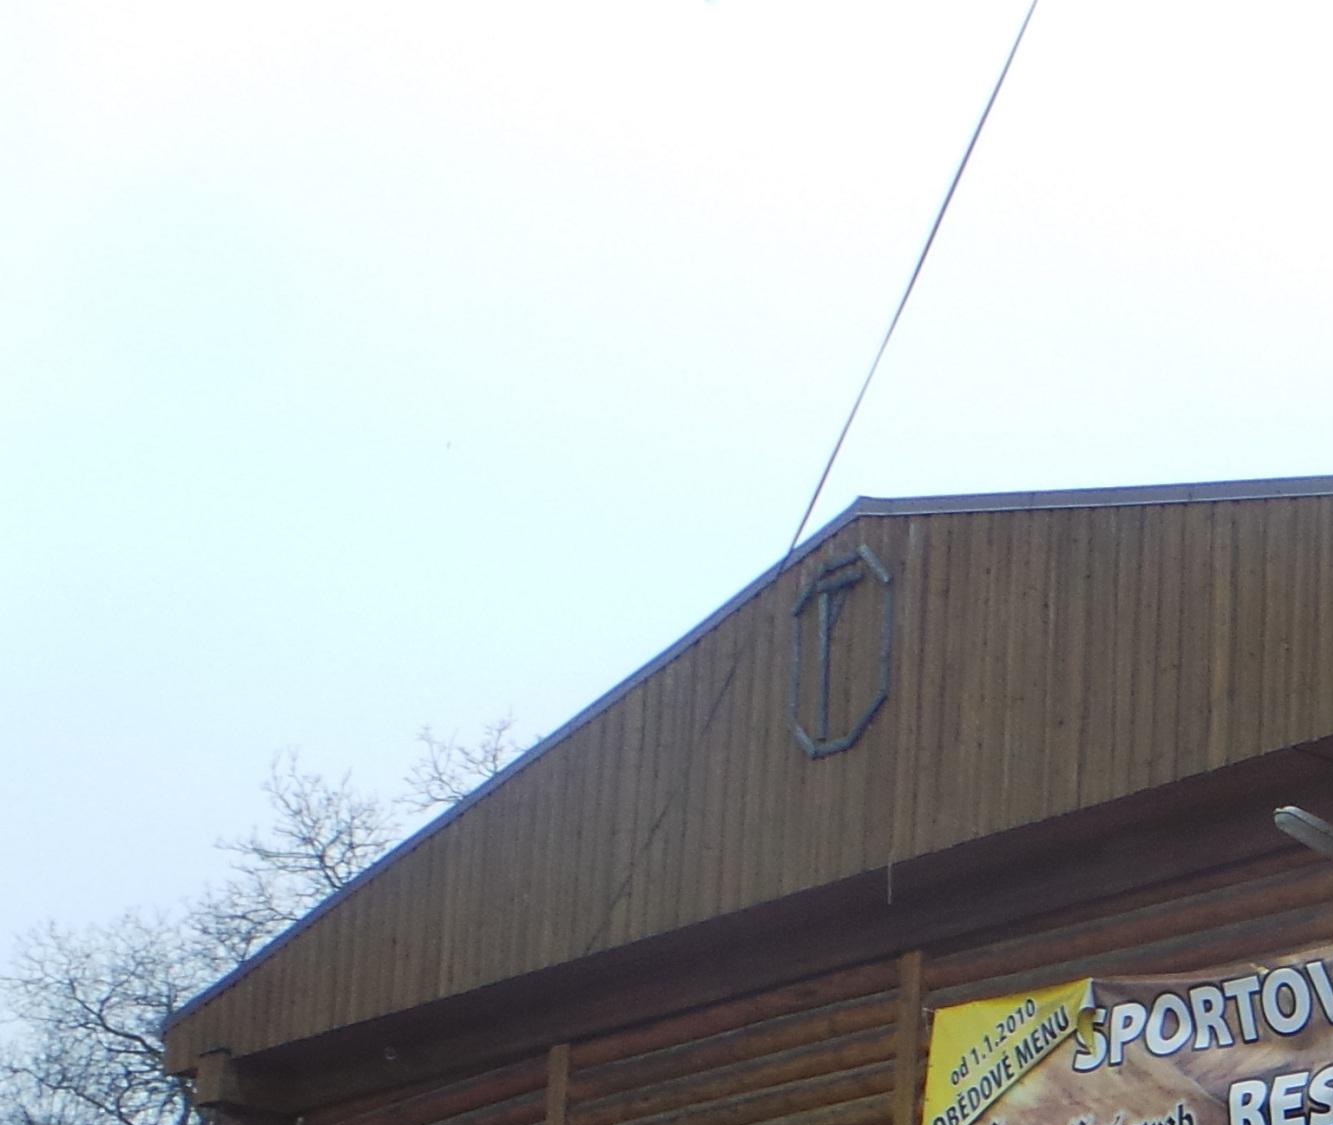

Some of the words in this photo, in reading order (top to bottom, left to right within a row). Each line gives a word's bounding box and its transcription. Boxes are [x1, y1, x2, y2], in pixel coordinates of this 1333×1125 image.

[951, 1064, 969, 1086] od
[971, 999, 1037, 1066] 1.1.2010
[1018, 1005, 1069, 1069] MENU
